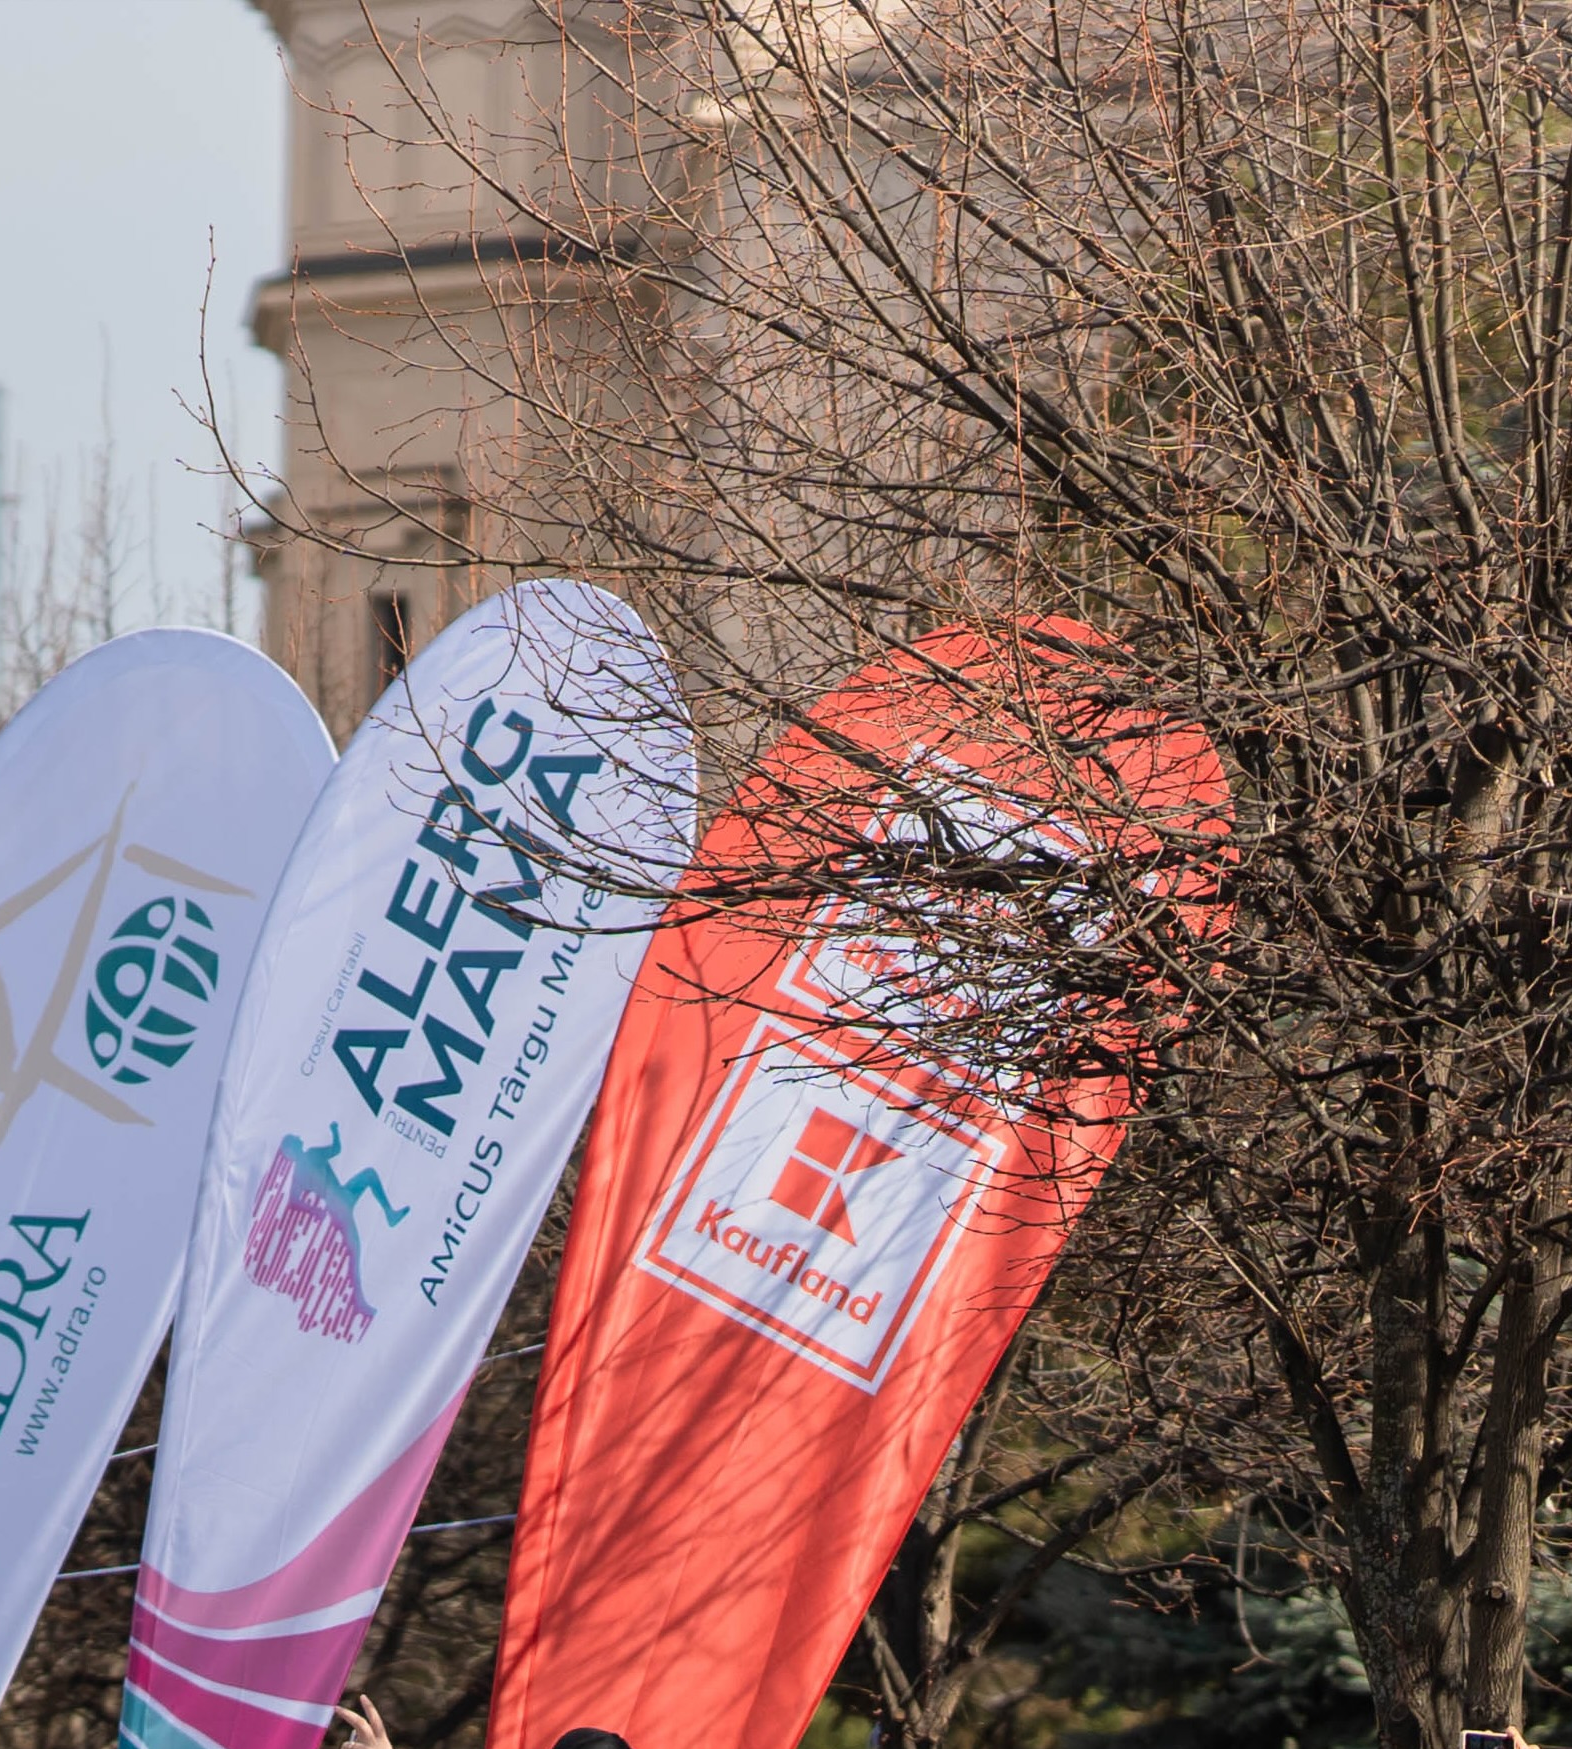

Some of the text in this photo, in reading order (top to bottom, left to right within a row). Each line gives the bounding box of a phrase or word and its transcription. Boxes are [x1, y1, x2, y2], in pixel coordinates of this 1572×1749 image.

[332, 695, 533, 1117] ALERG
[393, 755, 604, 1137] MAMA
[489, 1009, 557, 1121] Târgu
[541, 860, 611, 998] Mure
[300, 930, 368, 1078] Crosul Caritabil
[384, 1110, 449, 1159] PENTRU
[695, 1199, 883, 1328] Kaufland
[15, 1266, 107, 1456] www.adra.ro
